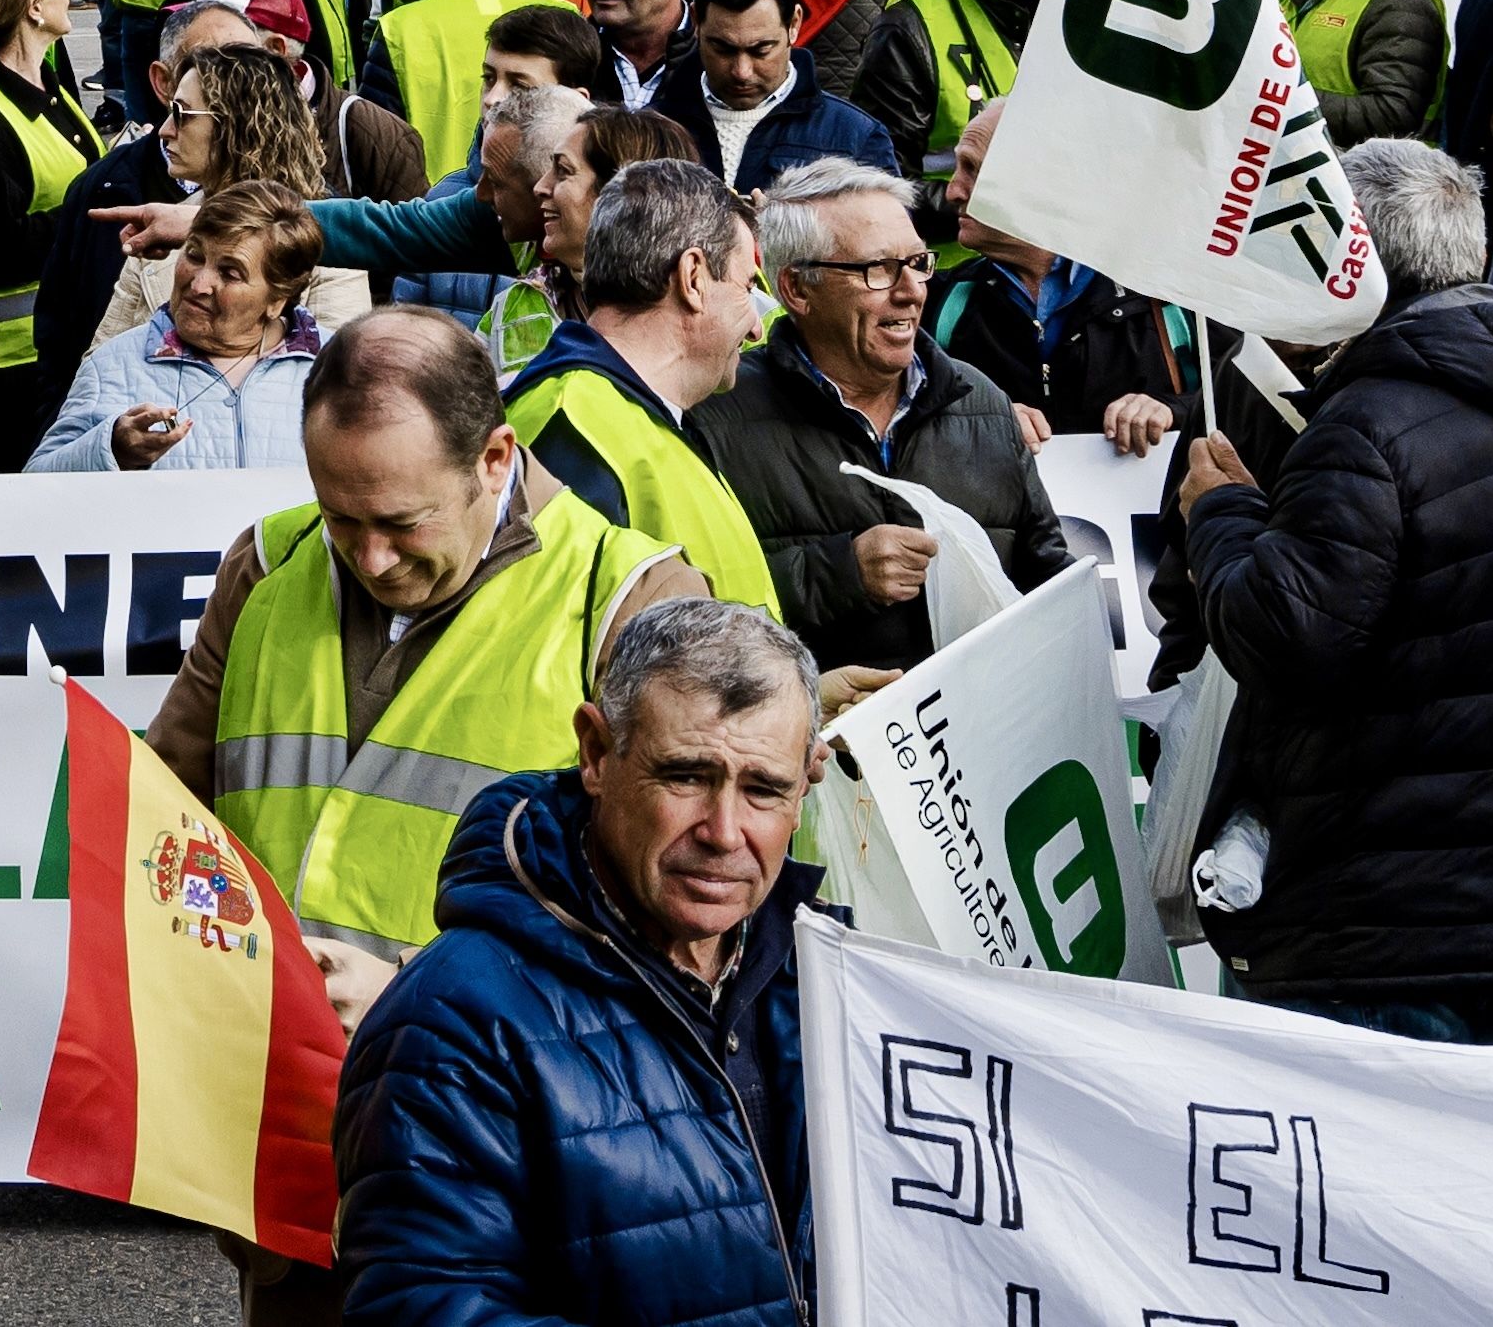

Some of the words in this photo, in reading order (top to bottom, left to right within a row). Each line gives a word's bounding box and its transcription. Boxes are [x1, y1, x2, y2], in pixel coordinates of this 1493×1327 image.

[1206, 137, 1271, 258] UNION
[1251, 78, 1291, 132] DE
[885, 720, 918, 771] de
[909, 777, 1006, 969] Agricultore
[915, 688, 984, 871] Unión
[984, 877, 1018, 954] de
[879, 1033, 1024, 1230] SI
[1185, 1100, 1390, 1294] EL
